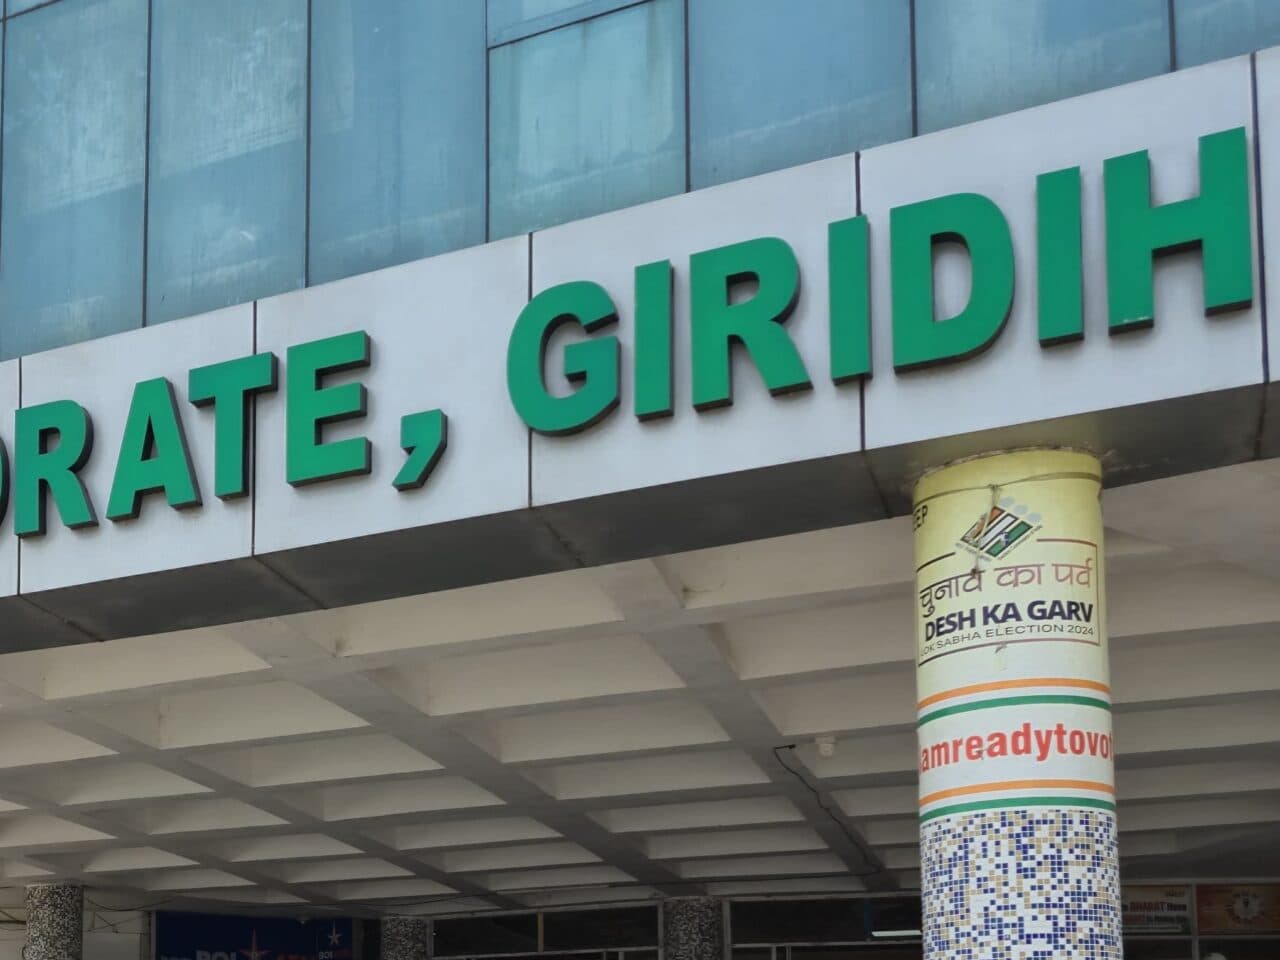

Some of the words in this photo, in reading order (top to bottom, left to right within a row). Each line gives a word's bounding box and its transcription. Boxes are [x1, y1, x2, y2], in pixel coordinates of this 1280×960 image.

[506, 126, 1254, 436] GIRIDIH
[994, 563, 1045, 588] का
[1051, 557, 1093, 588] पर्व
[925, 606, 976, 642] DESH
[982, 602, 1022, 626] KA
[1027, 600, 1094, 623] GARV
[936, 631, 982, 649] SABHA
[985, 624, 1064, 638] ELECTION
[1067, 624, 1094, 635] 2024
[919, 722, 1112, 773] amreadytovo
